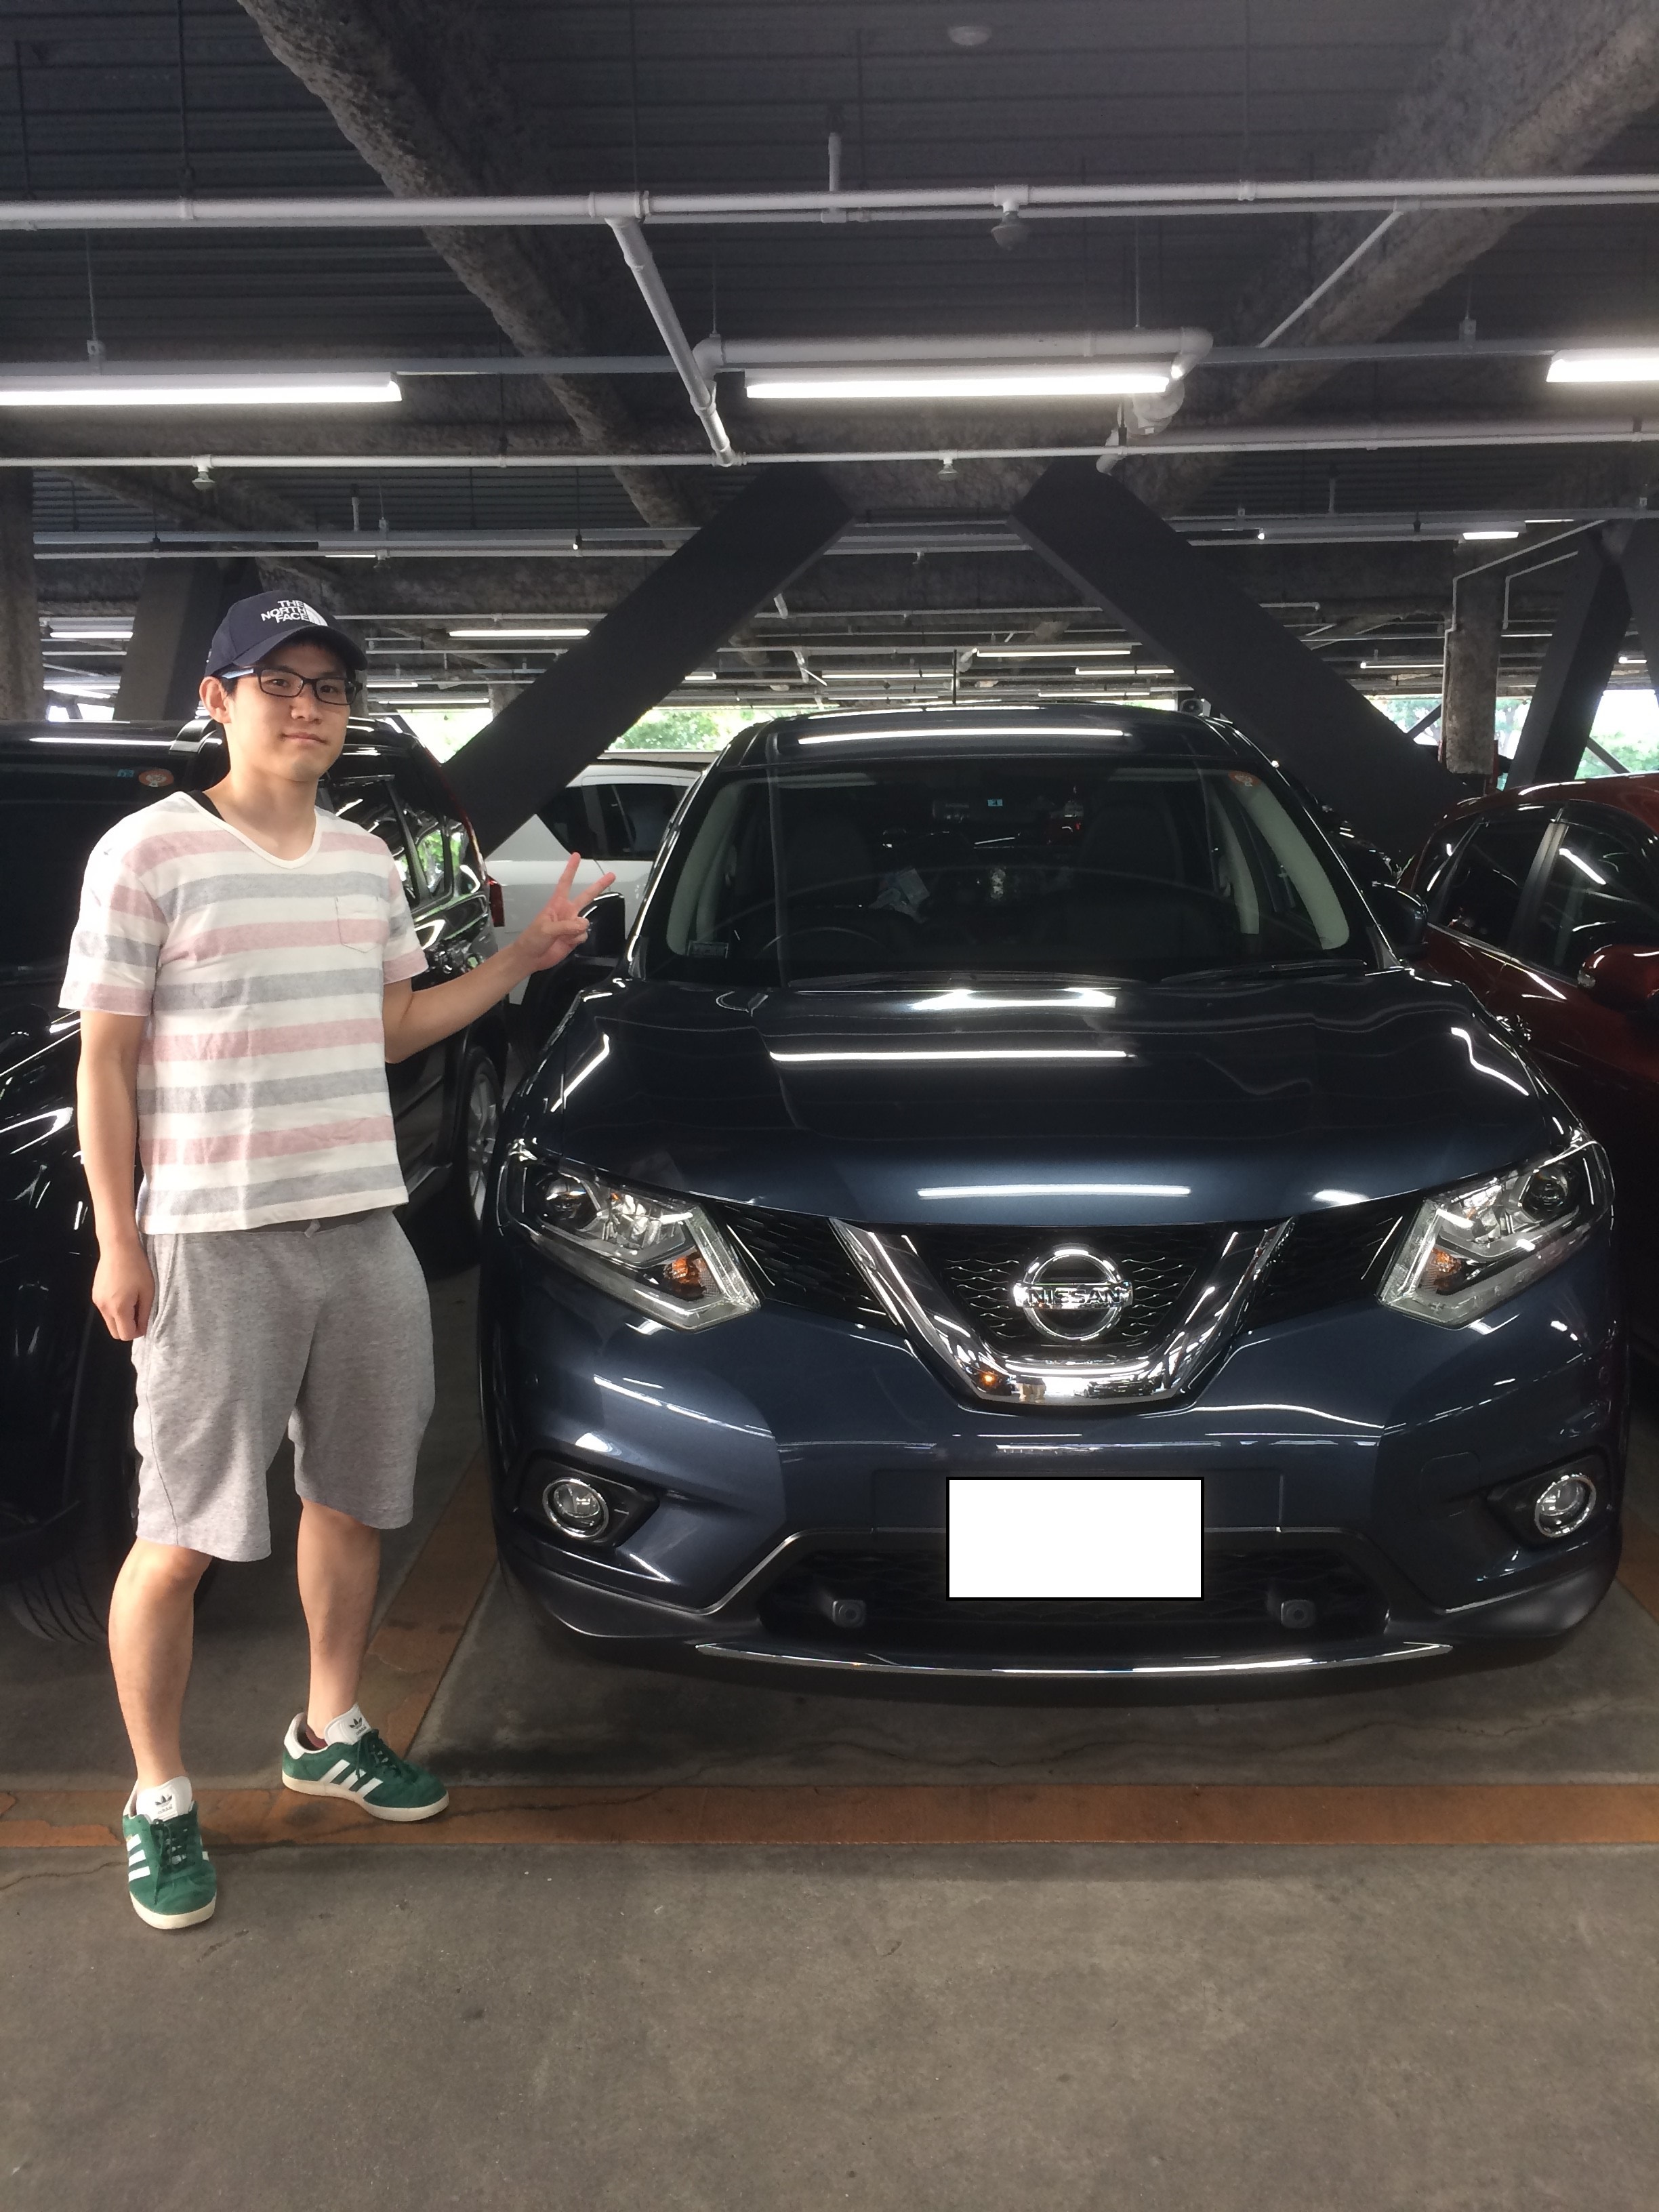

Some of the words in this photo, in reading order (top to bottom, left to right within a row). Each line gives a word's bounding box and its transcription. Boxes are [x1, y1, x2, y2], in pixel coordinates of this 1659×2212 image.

[277, 600, 304, 608] THE
[261, 606, 306, 621] NORTH
[274, 613, 310, 623] FACE
[1028, 1287, 1120, 1305] NISSAN
